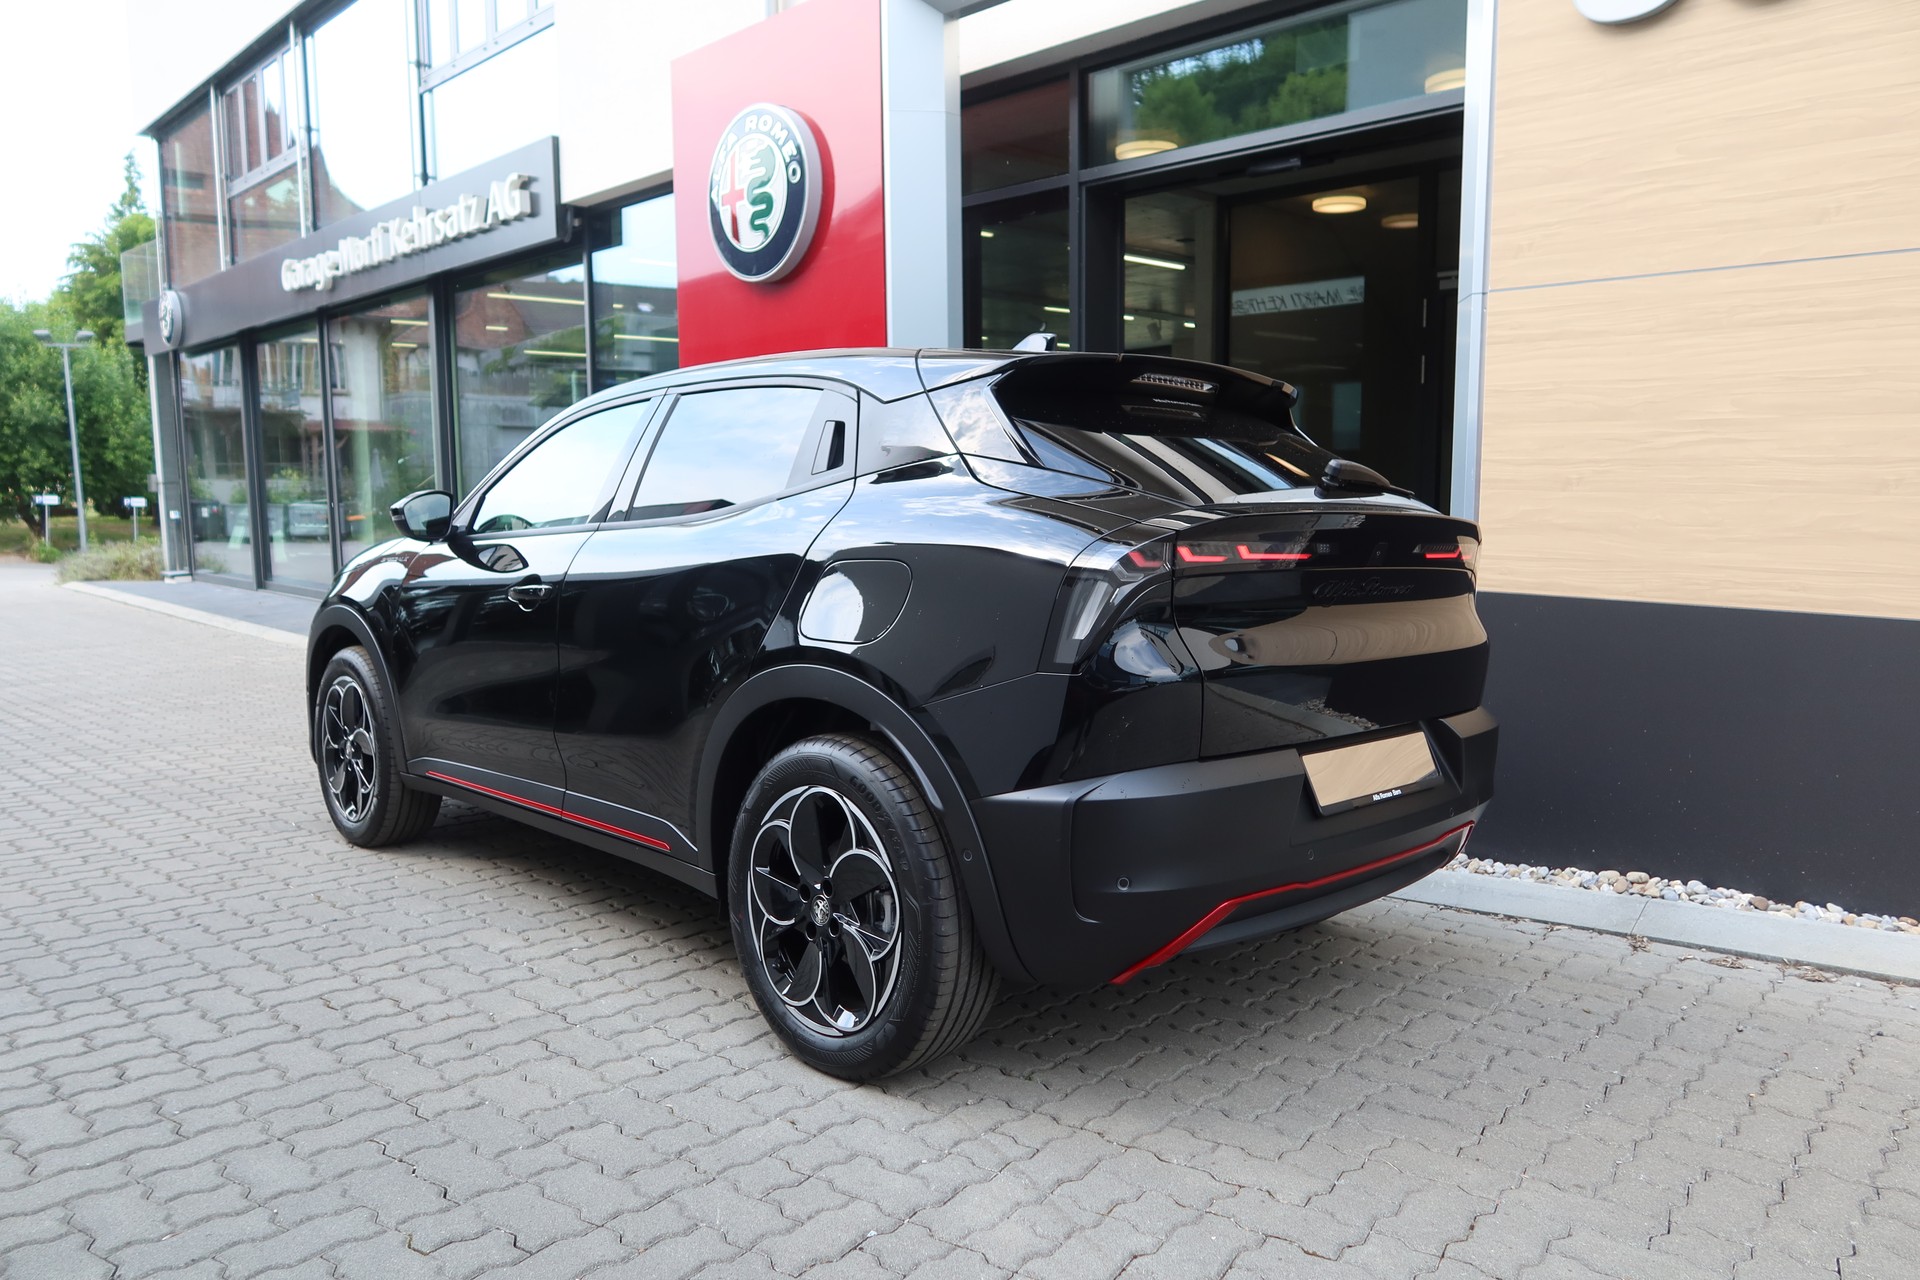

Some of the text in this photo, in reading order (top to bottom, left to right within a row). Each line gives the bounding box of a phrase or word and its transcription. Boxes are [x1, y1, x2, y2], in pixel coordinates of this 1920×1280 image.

[745, 114, 801, 184] ROMEO
[282, 254, 341, 292] Garage
[389, 194, 484, 257] Kehrsatz
[488, 172, 532, 225] AG
